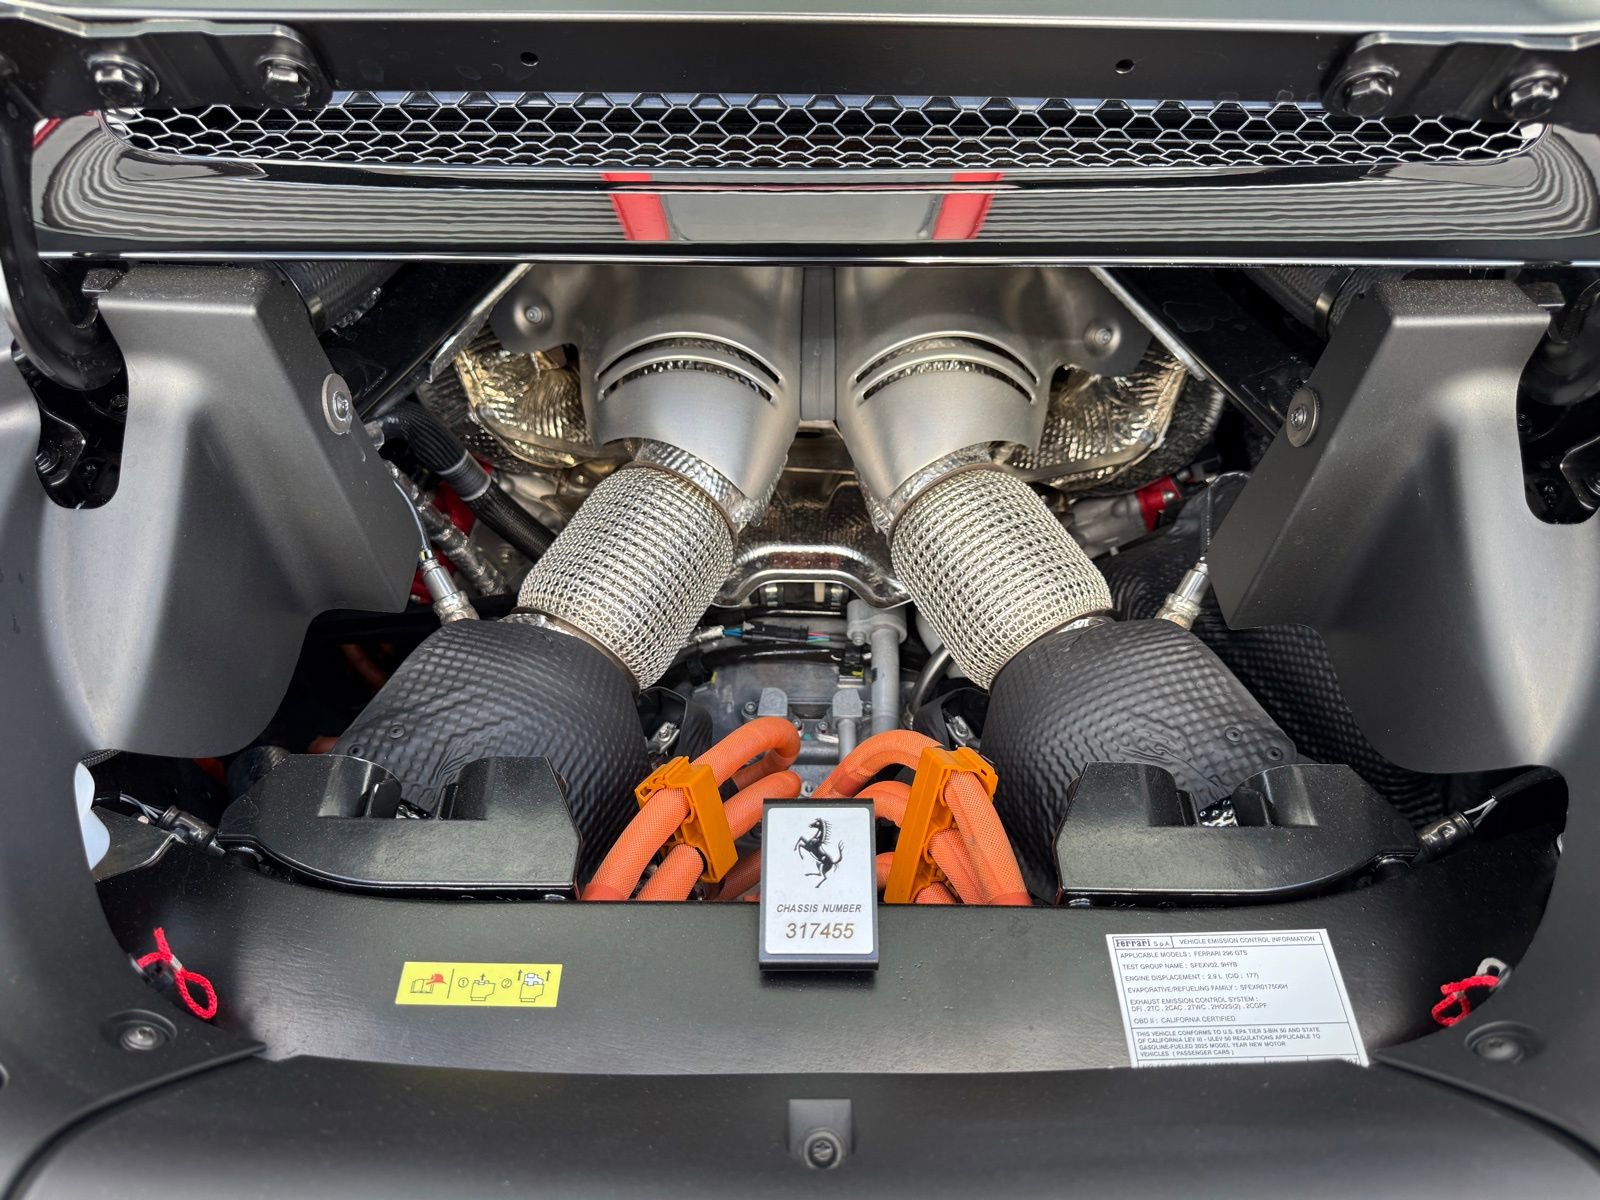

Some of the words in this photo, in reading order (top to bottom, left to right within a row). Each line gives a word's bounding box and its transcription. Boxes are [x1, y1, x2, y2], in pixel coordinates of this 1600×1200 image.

[776, 904, 818, 913] CHASSIS
[822, 904, 862, 913] NUMBER
[786, 922, 854, 938] 317455
[1116, 939, 1150, 947] Ferrari
[1128, 986, 1210, 994] EVAPORATIVE/REFUELING
[1194, 996, 1228, 1004] CONTROL
